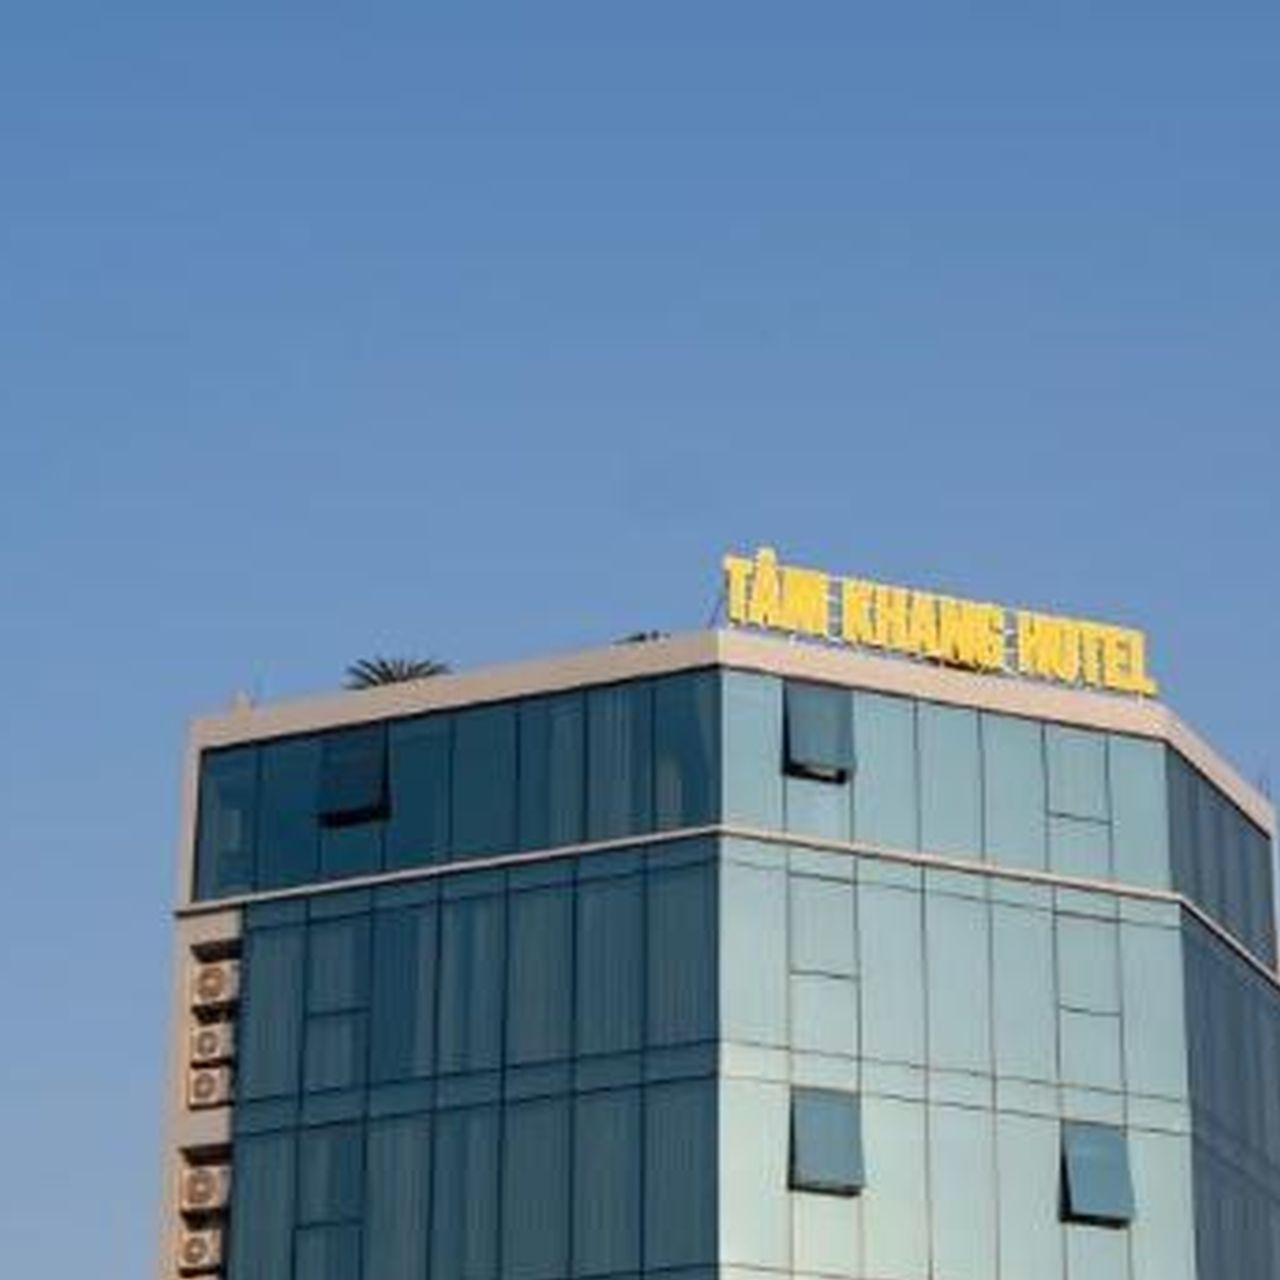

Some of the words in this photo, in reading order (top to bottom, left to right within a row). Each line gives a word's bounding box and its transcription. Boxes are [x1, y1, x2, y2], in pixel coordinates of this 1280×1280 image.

[724, 547, 828, 636] TÂM
[842, 576, 1005, 669] KHANG
[1018, 609, 1157, 696] HOTEL
